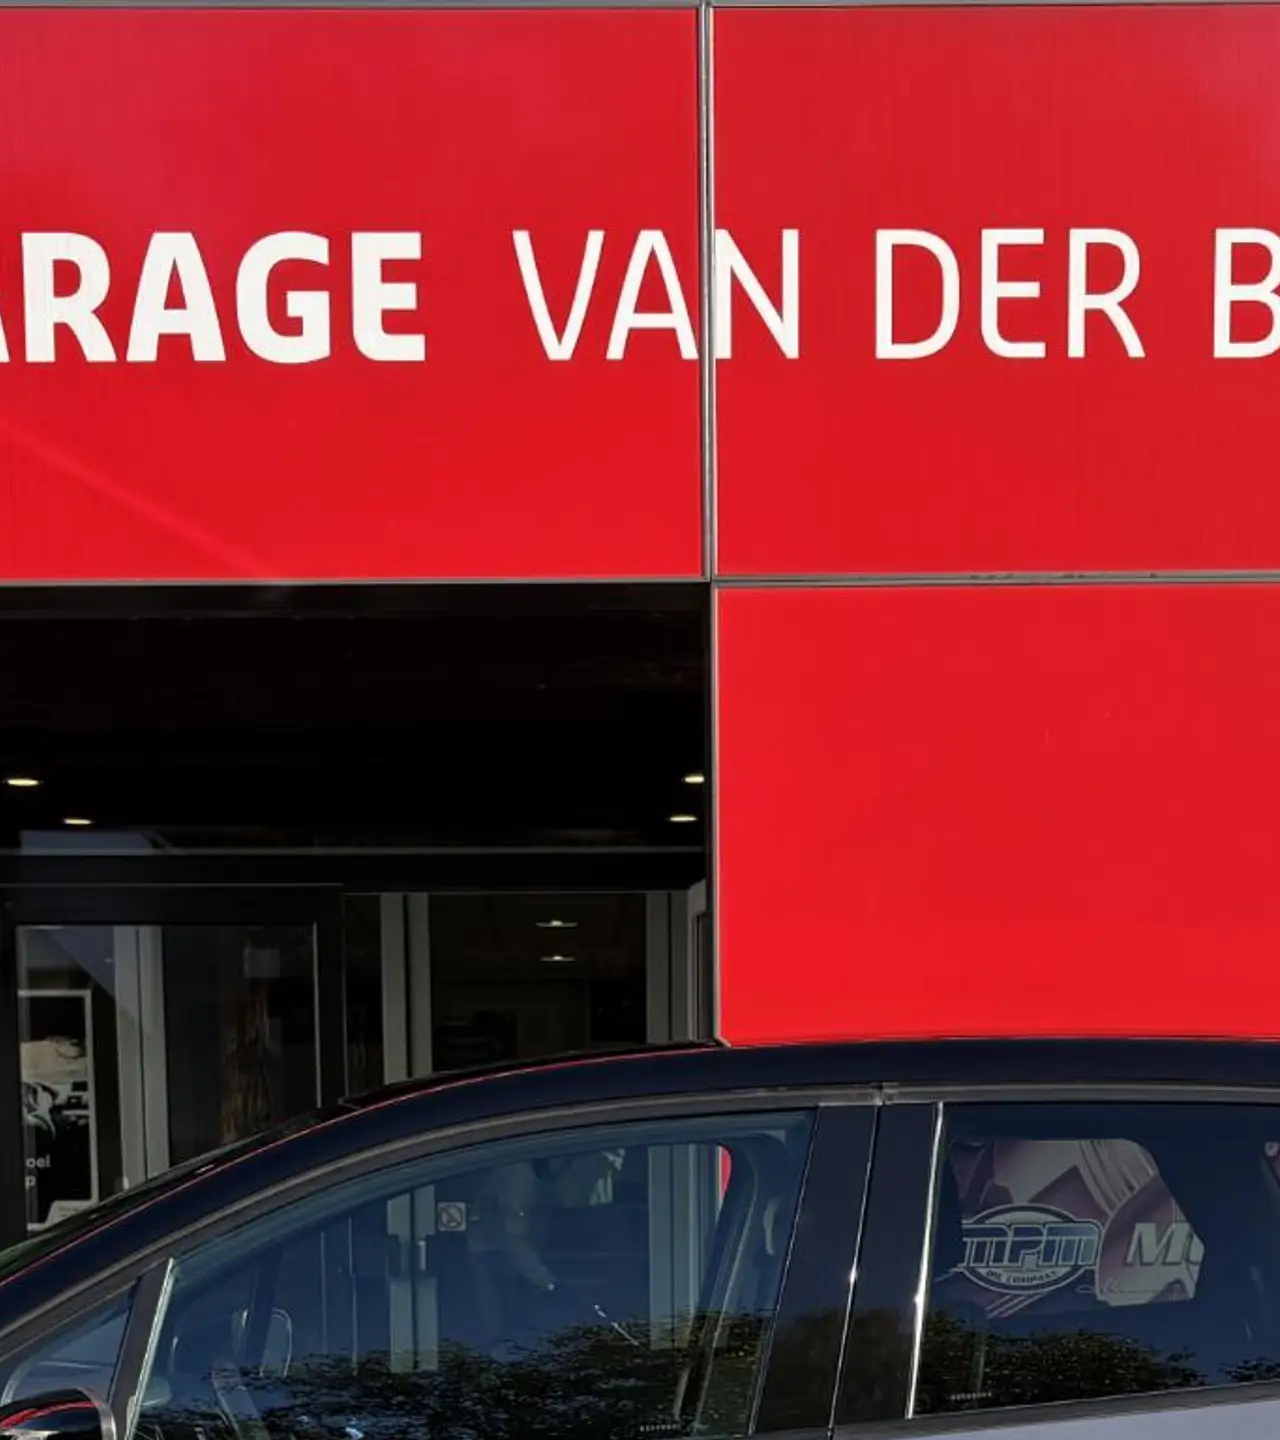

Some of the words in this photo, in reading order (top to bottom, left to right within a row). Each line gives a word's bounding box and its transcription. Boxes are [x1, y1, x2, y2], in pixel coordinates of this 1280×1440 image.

[513, 229, 800, 362] VAN
[874, 228, 1145, 361] DER
[25, 1154, 51, 1169] oel
